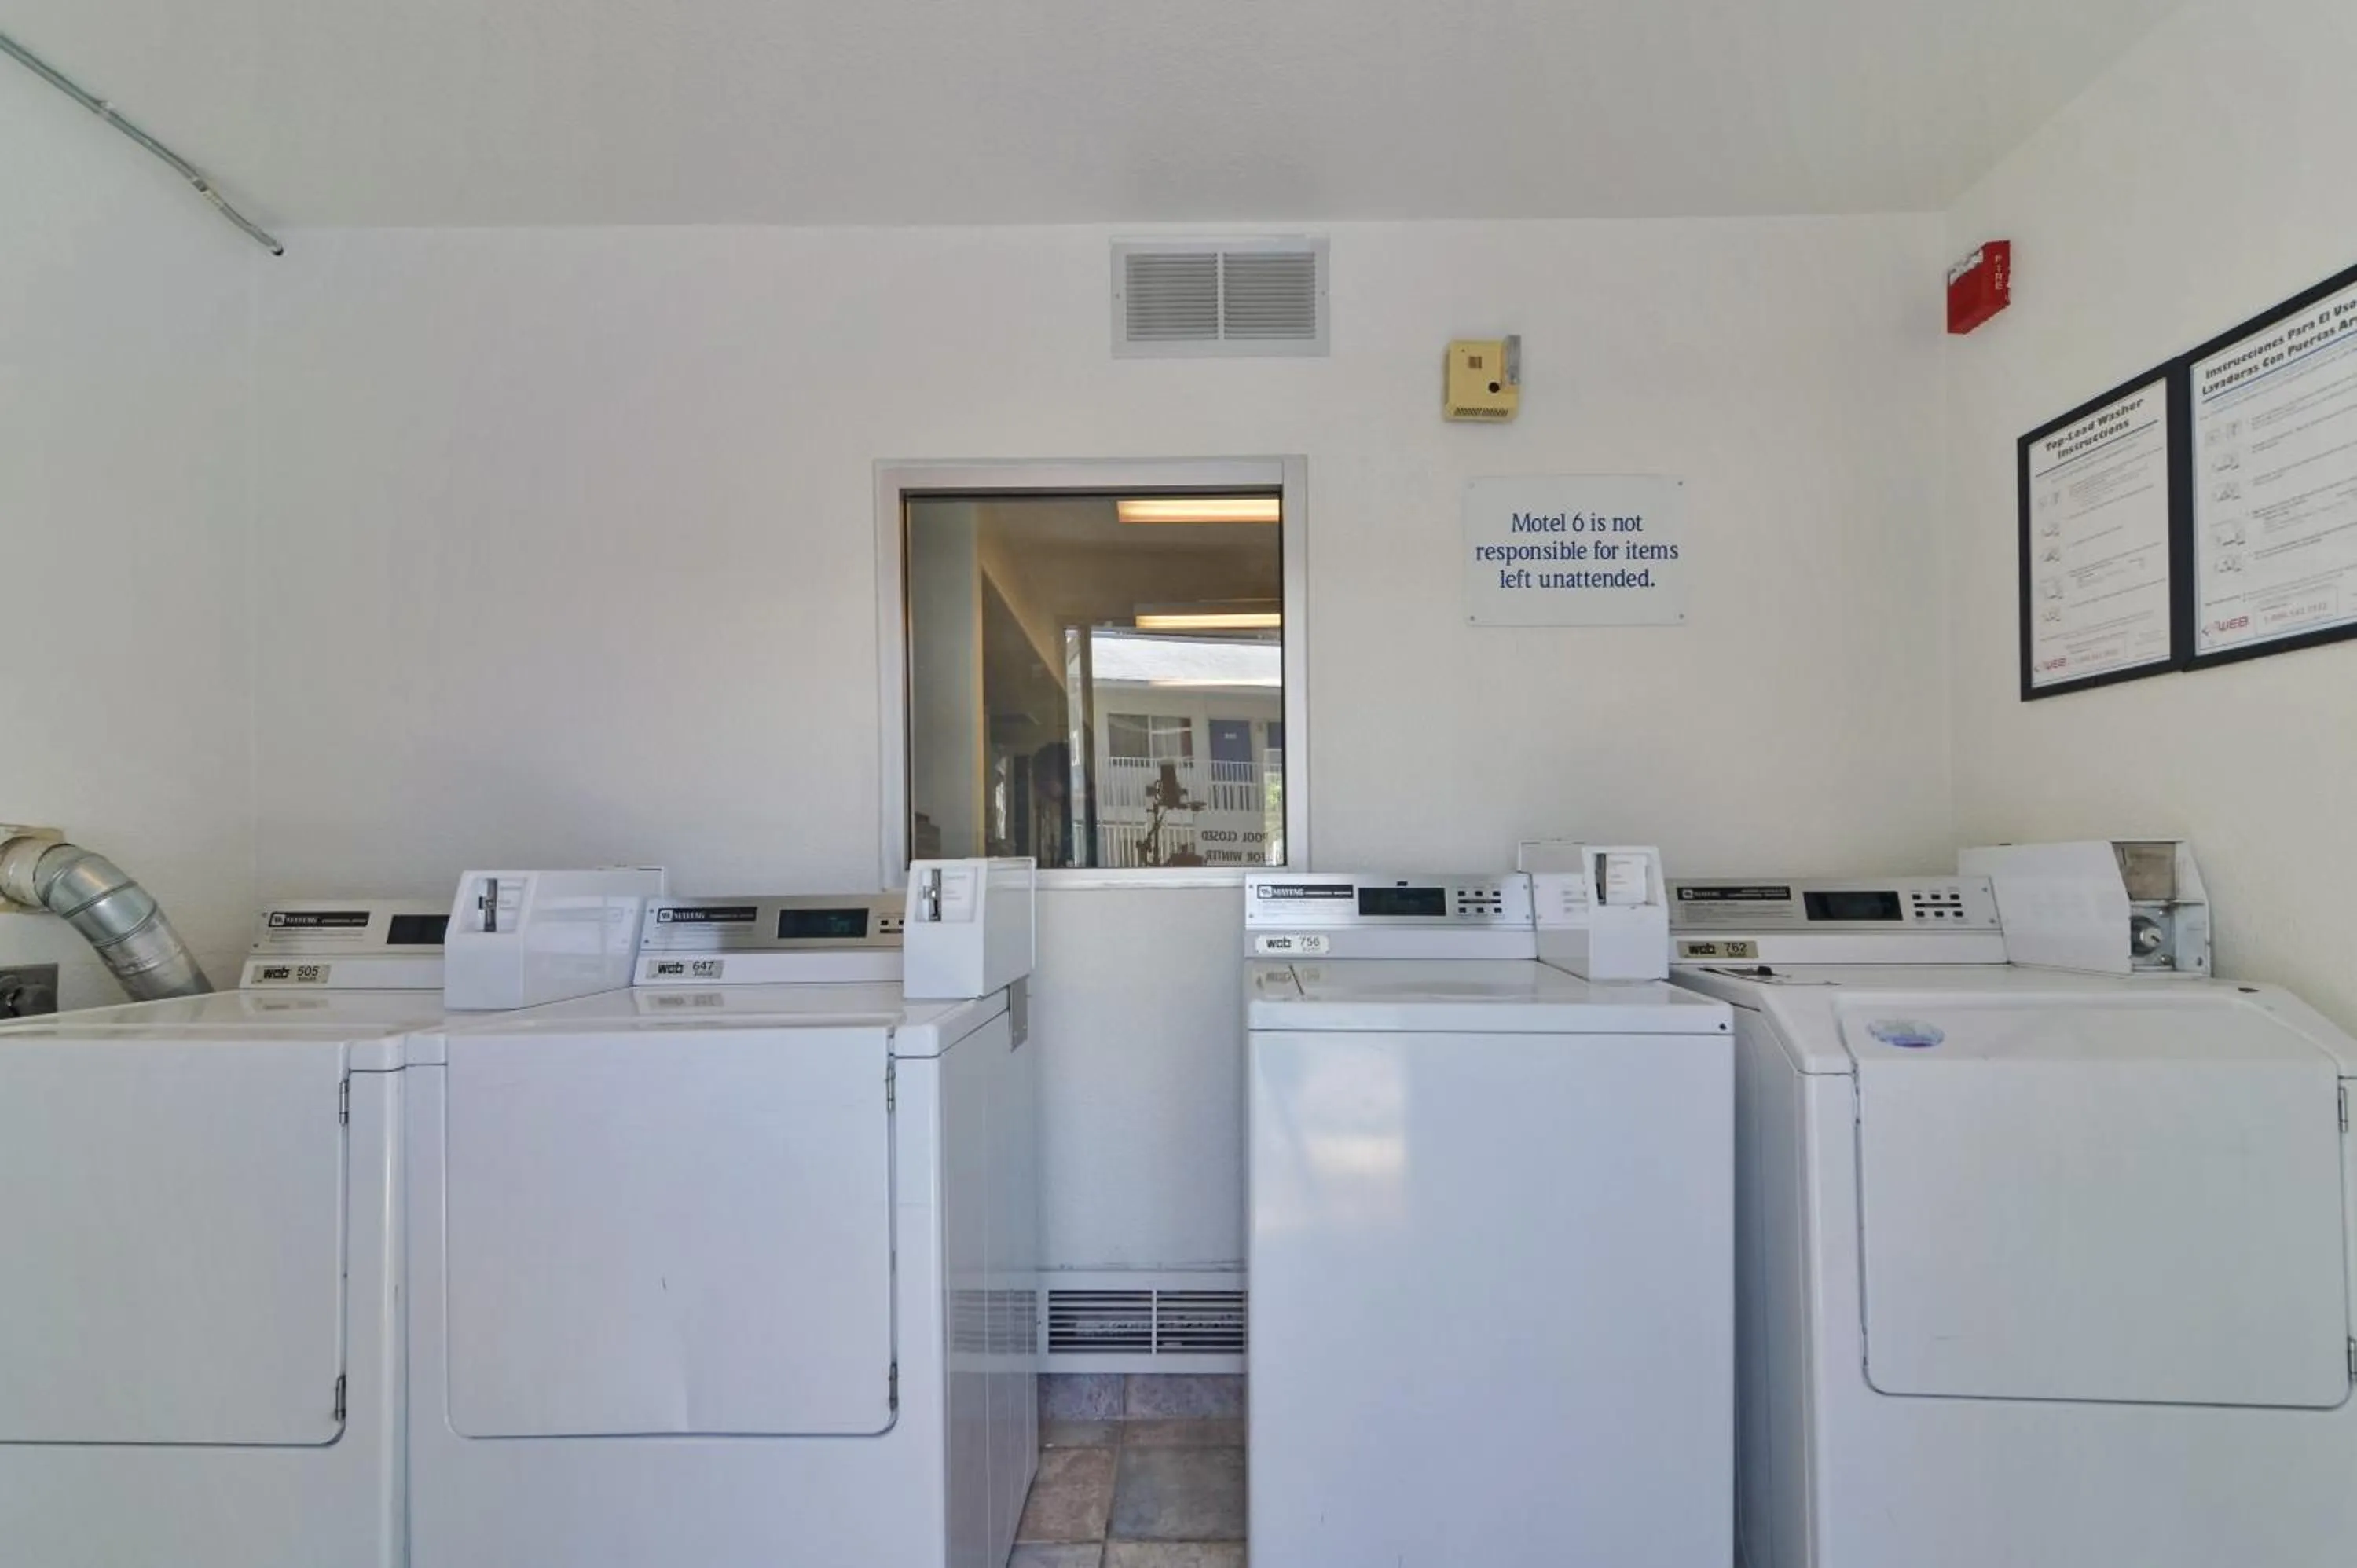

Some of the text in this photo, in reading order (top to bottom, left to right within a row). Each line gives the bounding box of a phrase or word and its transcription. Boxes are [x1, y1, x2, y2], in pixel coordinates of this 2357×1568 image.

[2287, 320, 2316, 341] Para
[2319, 310, 2330, 324] El
[2202, 363, 2260, 395] Lavadoras
[2262, 353, 2285, 368] Con
[2288, 327, 2336, 357] Puertas
[2045, 397, 2144, 452] Top-Load Washer
[2057, 419, 2130, 460] Instructions
[1512, 512, 1643, 533] Motel 6 is not
[1475, 540, 1680, 566] responsible for items
[1500, 568, 1656, 588] left unattended.
[297, 965, 320, 976] 505
[692, 961, 714, 971] 647
